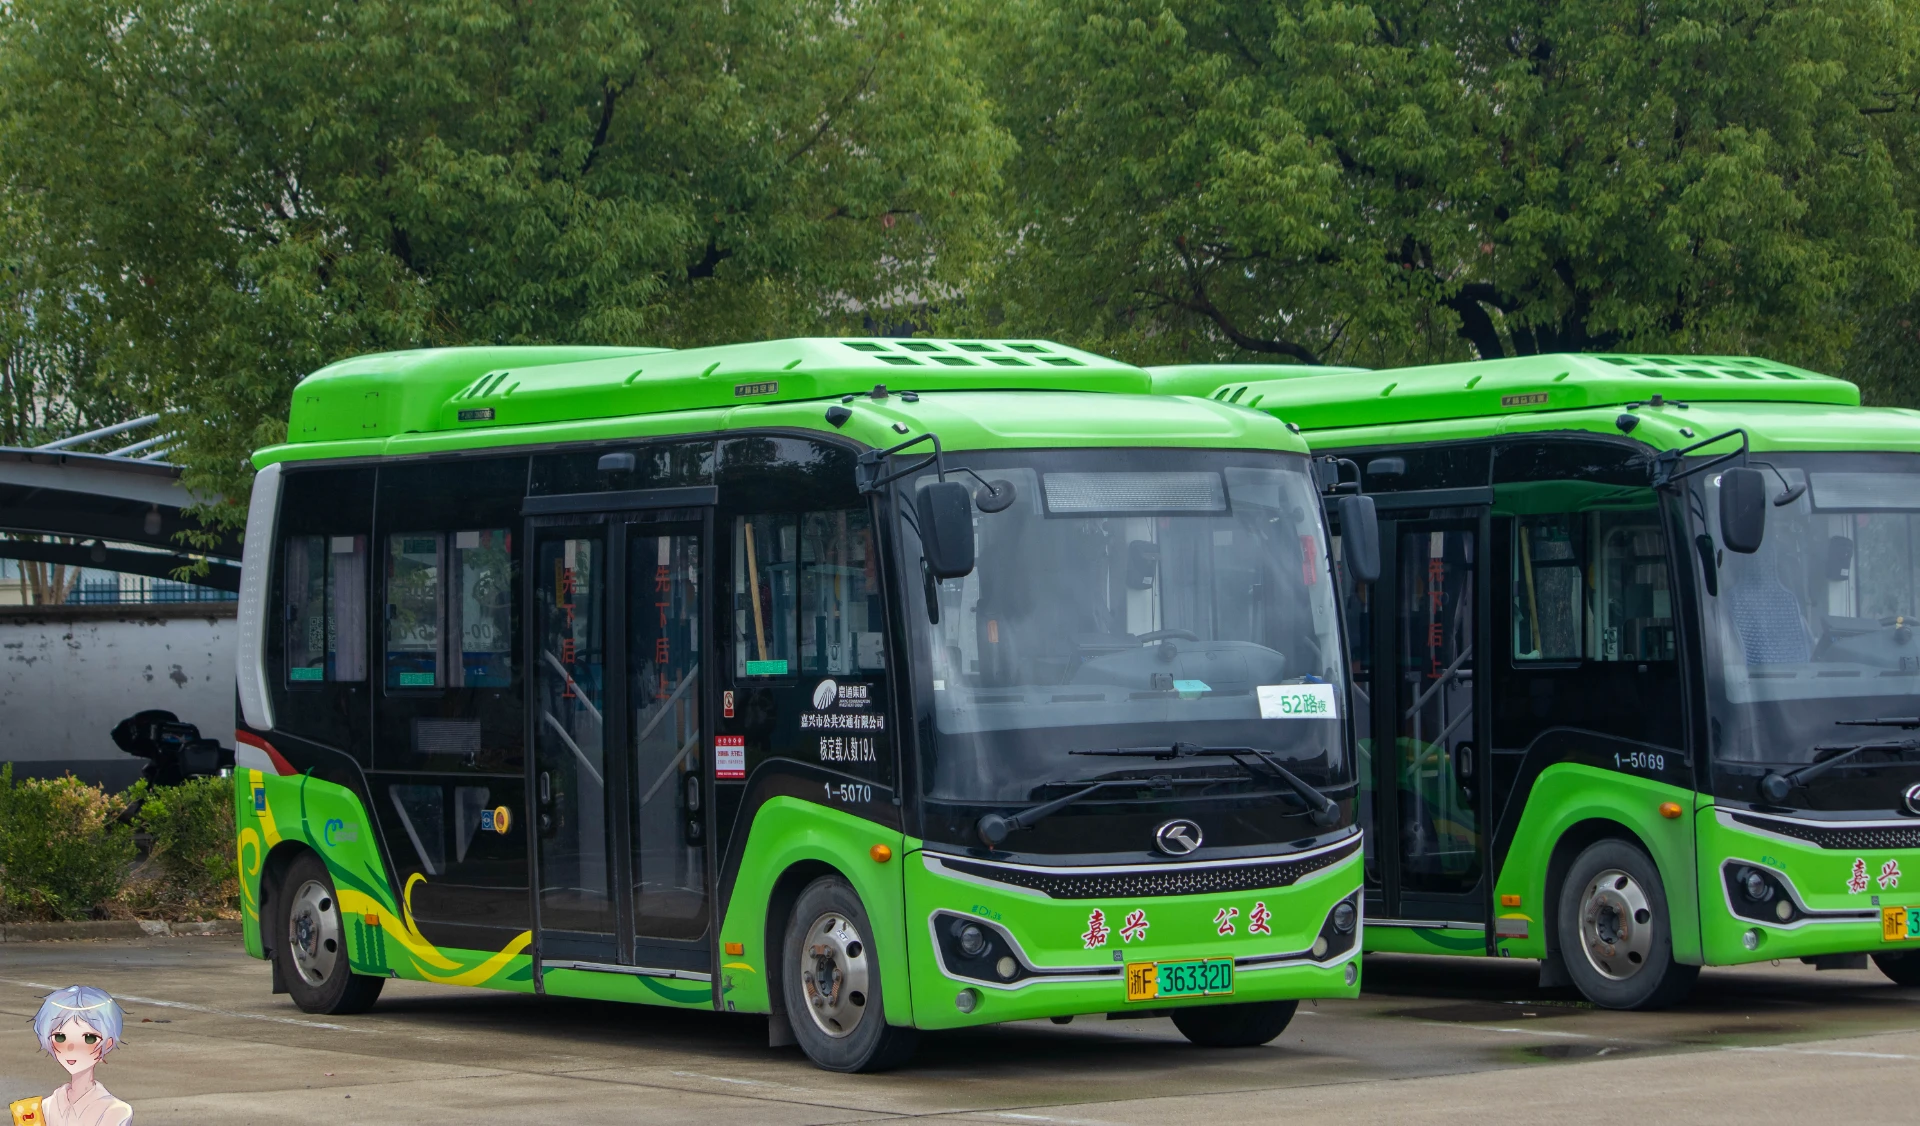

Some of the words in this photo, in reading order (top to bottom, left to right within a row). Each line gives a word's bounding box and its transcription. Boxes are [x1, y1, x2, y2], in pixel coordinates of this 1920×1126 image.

[561, 567, 577, 698] 先下后上
[655, 565, 671, 699] 先下后上
[1427, 557, 1444, 679] 先下后上
[1281, 693, 1327, 714] 52路夜
[800, 713, 884, 730] 嘉兴市公共交通有限公司
[820, 736, 876, 762] 核定载人数19人
[1614, 752, 1664, 771] 1-5069
[824, 781, 871, 803] 1-5070
[1846, 857, 1901, 894] 嘉兴
[1081, 908, 1149, 949] 嘉兴
[1213, 901, 1271, 936] 公交
